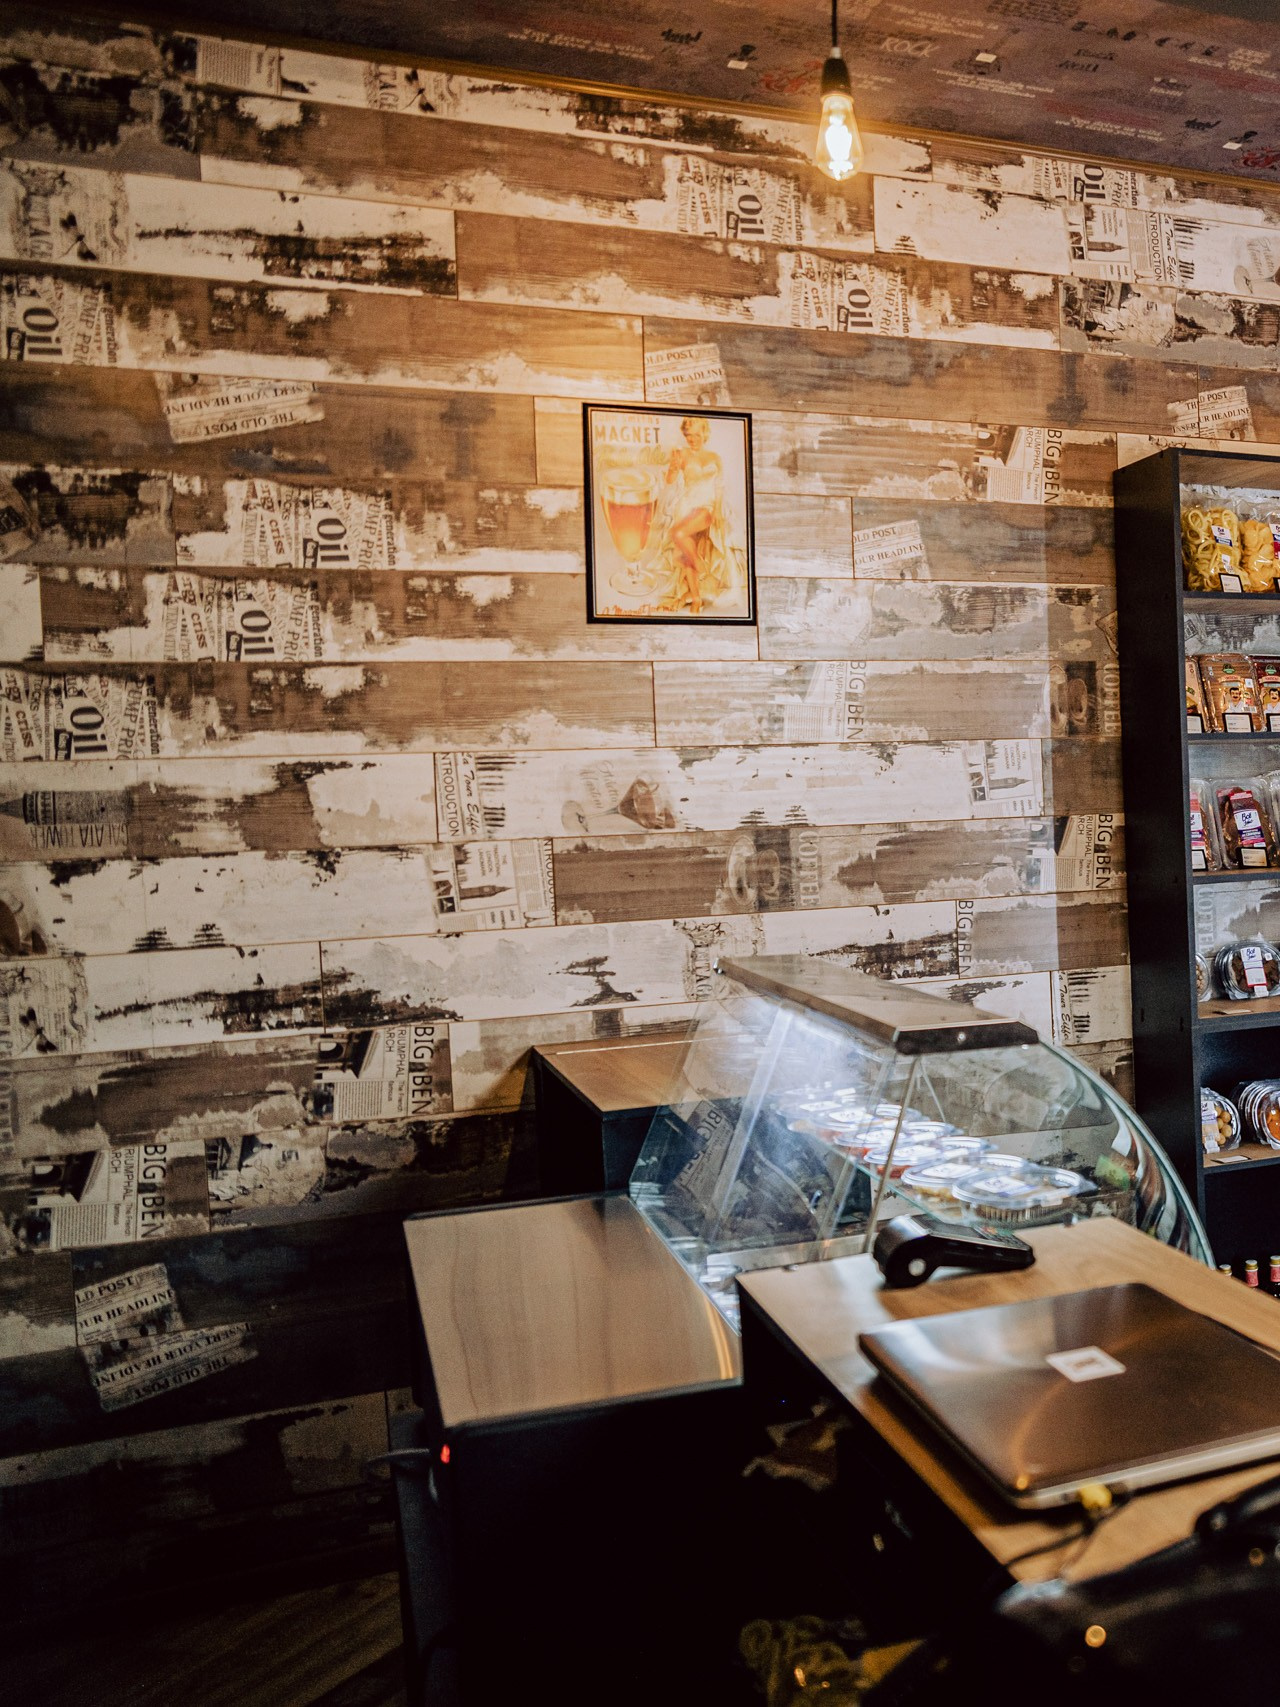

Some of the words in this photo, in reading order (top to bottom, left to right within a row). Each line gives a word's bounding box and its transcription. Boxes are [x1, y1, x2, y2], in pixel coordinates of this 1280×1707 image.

[738, 194, 764, 235] Oil
[848, 288, 874, 328] Oil
[23, 307, 63, 356] Oil
[666, 349, 694, 361] POST
[1207, 390, 1228, 402] POST
[203, 423, 238, 436] POST
[241, 418, 268, 431] OLD
[270, 411, 297, 426] THE
[1211, 407, 1251, 422] HEADLINE
[594, 425, 661, 444] MAGNET
[1045, 428, 1062, 458] BIG
[1044, 470, 1060, 505] BEN
[317, 518, 349, 563] Oil
[872, 526, 896, 540] POST
[877, 543, 926, 560] HEADLINE
[240, 609, 275, 655] Oil
[849, 661, 866, 691] BIG
[70, 706, 108, 754] Oil
[847, 703, 864, 740] BEN
[441, 753, 459, 837] NTRODUCTION
[1096, 814, 1113, 848] BIG
[1095, 858, 1112, 889] BEN
[958, 900, 974, 932] BIG
[956, 943, 972, 976] BEN
[413, 1026, 434, 1059] BIG
[411, 1075, 433, 1115] BEN
[143, 1144, 167, 1187] BIG
[140, 1195, 165, 1239] BEN
[98, 1276, 135, 1297] POST
[106, 1288, 176, 1322] HEADLINE
